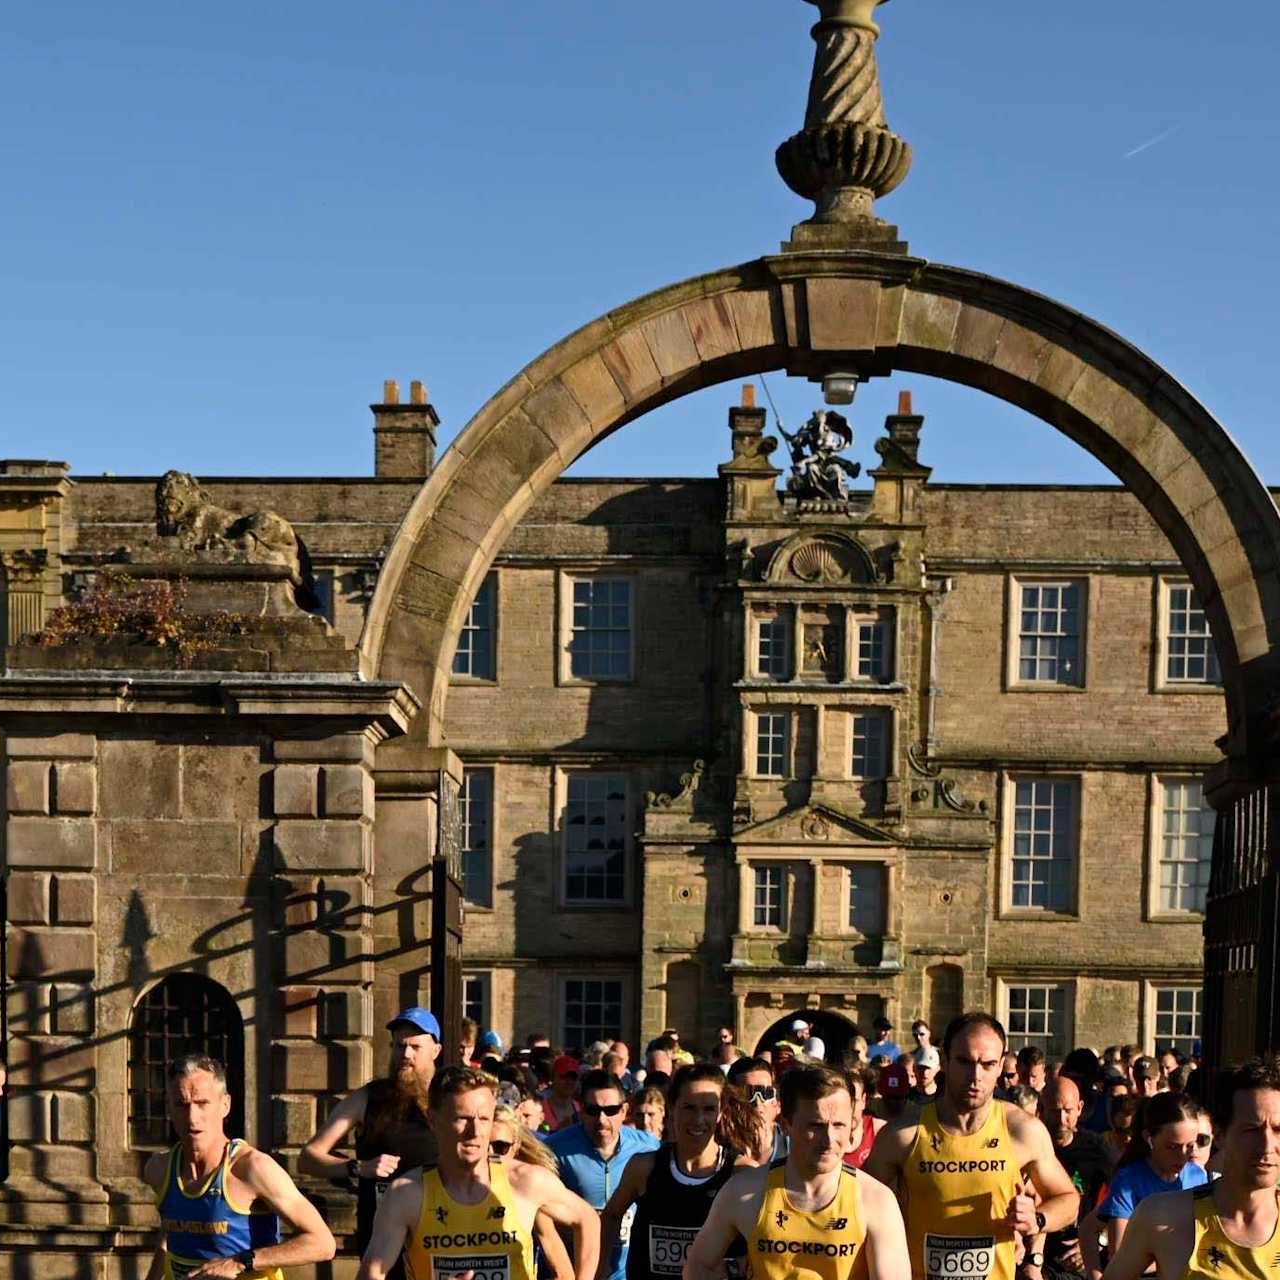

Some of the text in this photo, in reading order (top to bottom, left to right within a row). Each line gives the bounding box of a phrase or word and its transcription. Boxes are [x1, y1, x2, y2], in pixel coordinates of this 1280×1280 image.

[918, 1159, 1007, 1174] STOCKPORT
[423, 1231, 517, 1250] STOCKPORT
[757, 1240, 856, 1258] STOCKPORT
[929, 1250, 990, 1273] 5669
